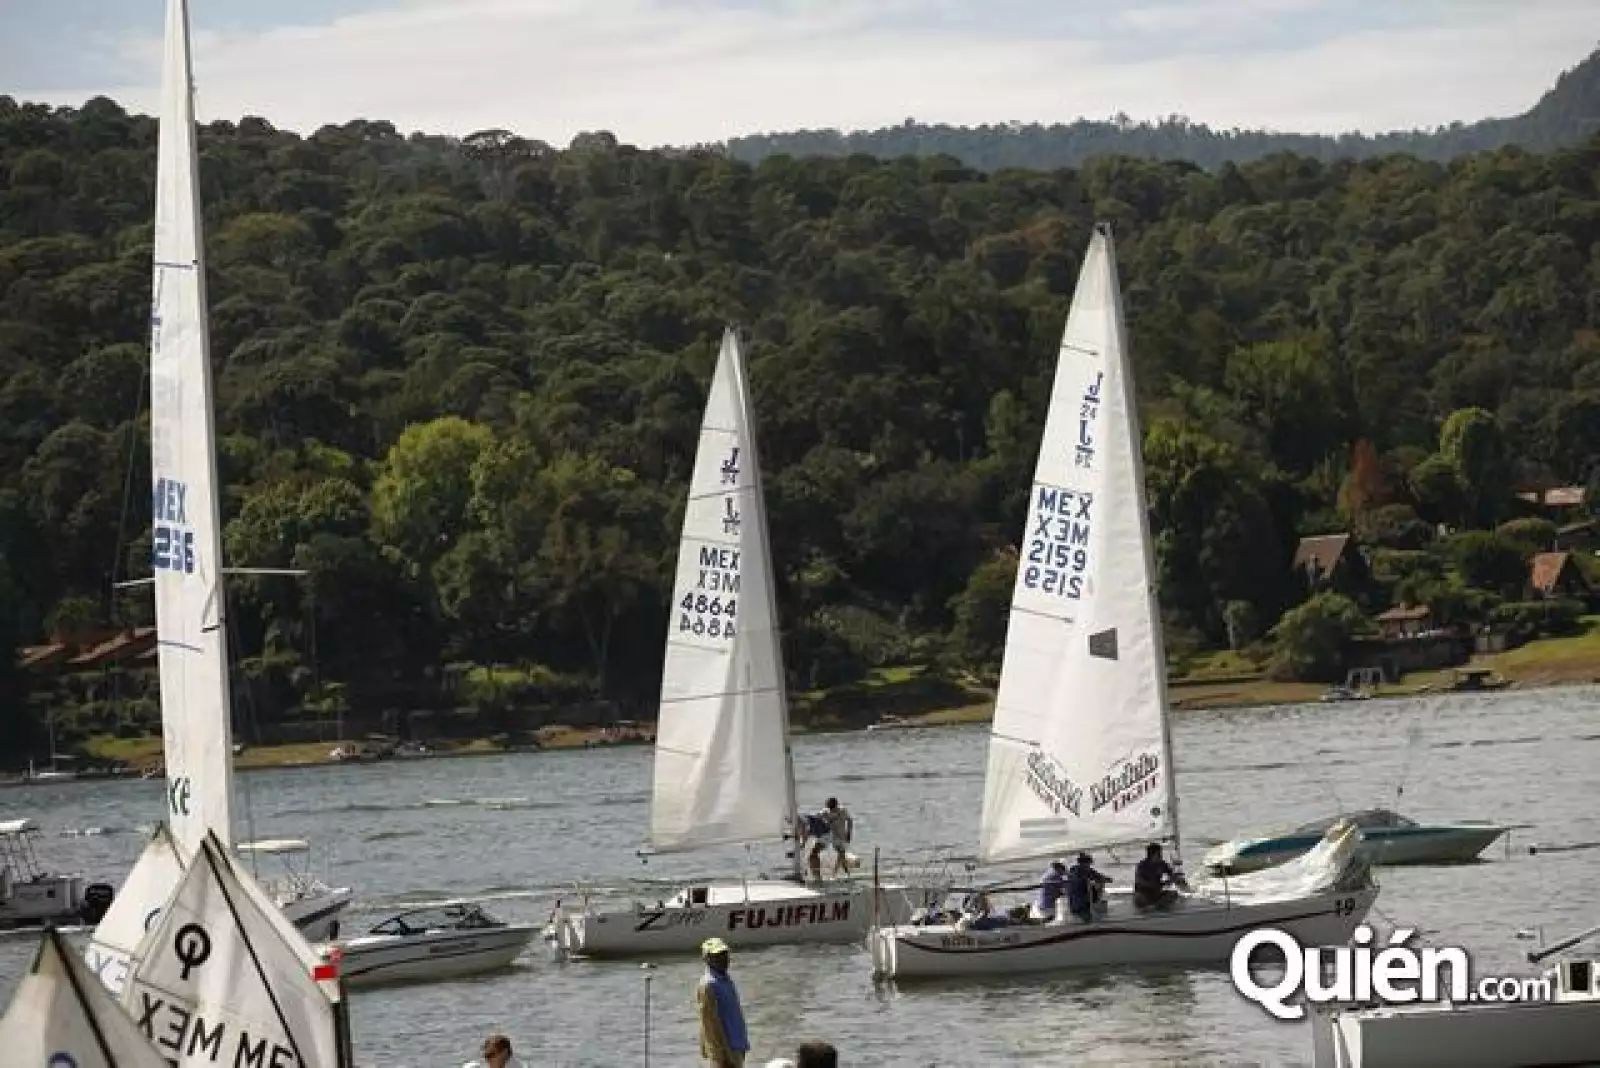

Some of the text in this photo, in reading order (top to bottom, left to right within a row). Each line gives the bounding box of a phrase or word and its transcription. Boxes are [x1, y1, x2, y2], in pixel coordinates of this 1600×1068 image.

[1037, 487, 1093, 521] MEX
[699, 547, 741, 571] MEX
[1029, 540, 1086, 572] 2159
[680, 592, 736, 619] 4864
[728, 899, 850, 931] FUJIFILM
